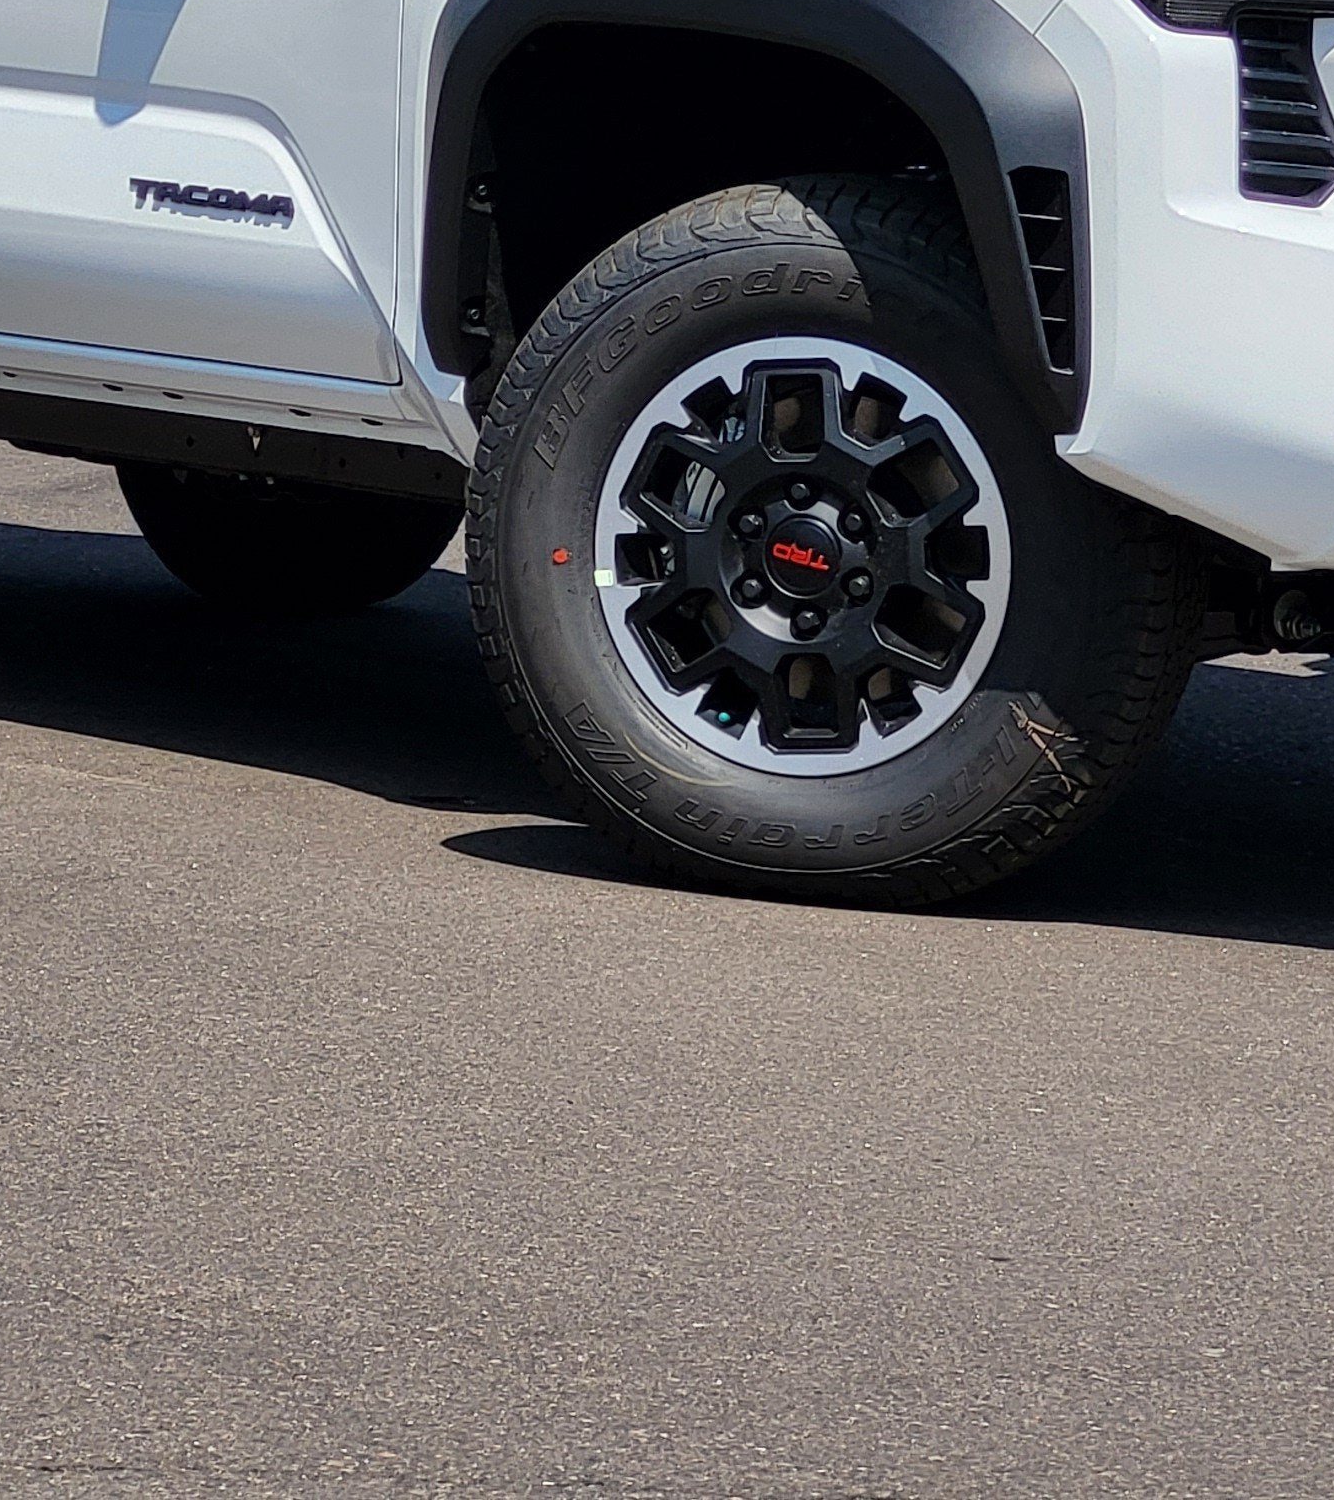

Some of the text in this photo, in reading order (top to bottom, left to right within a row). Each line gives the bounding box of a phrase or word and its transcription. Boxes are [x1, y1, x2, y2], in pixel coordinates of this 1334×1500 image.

[129, 177, 295, 221] TACOMA
[534, 262, 872, 468] BFGoodri
[773, 543, 829, 571] TRD
